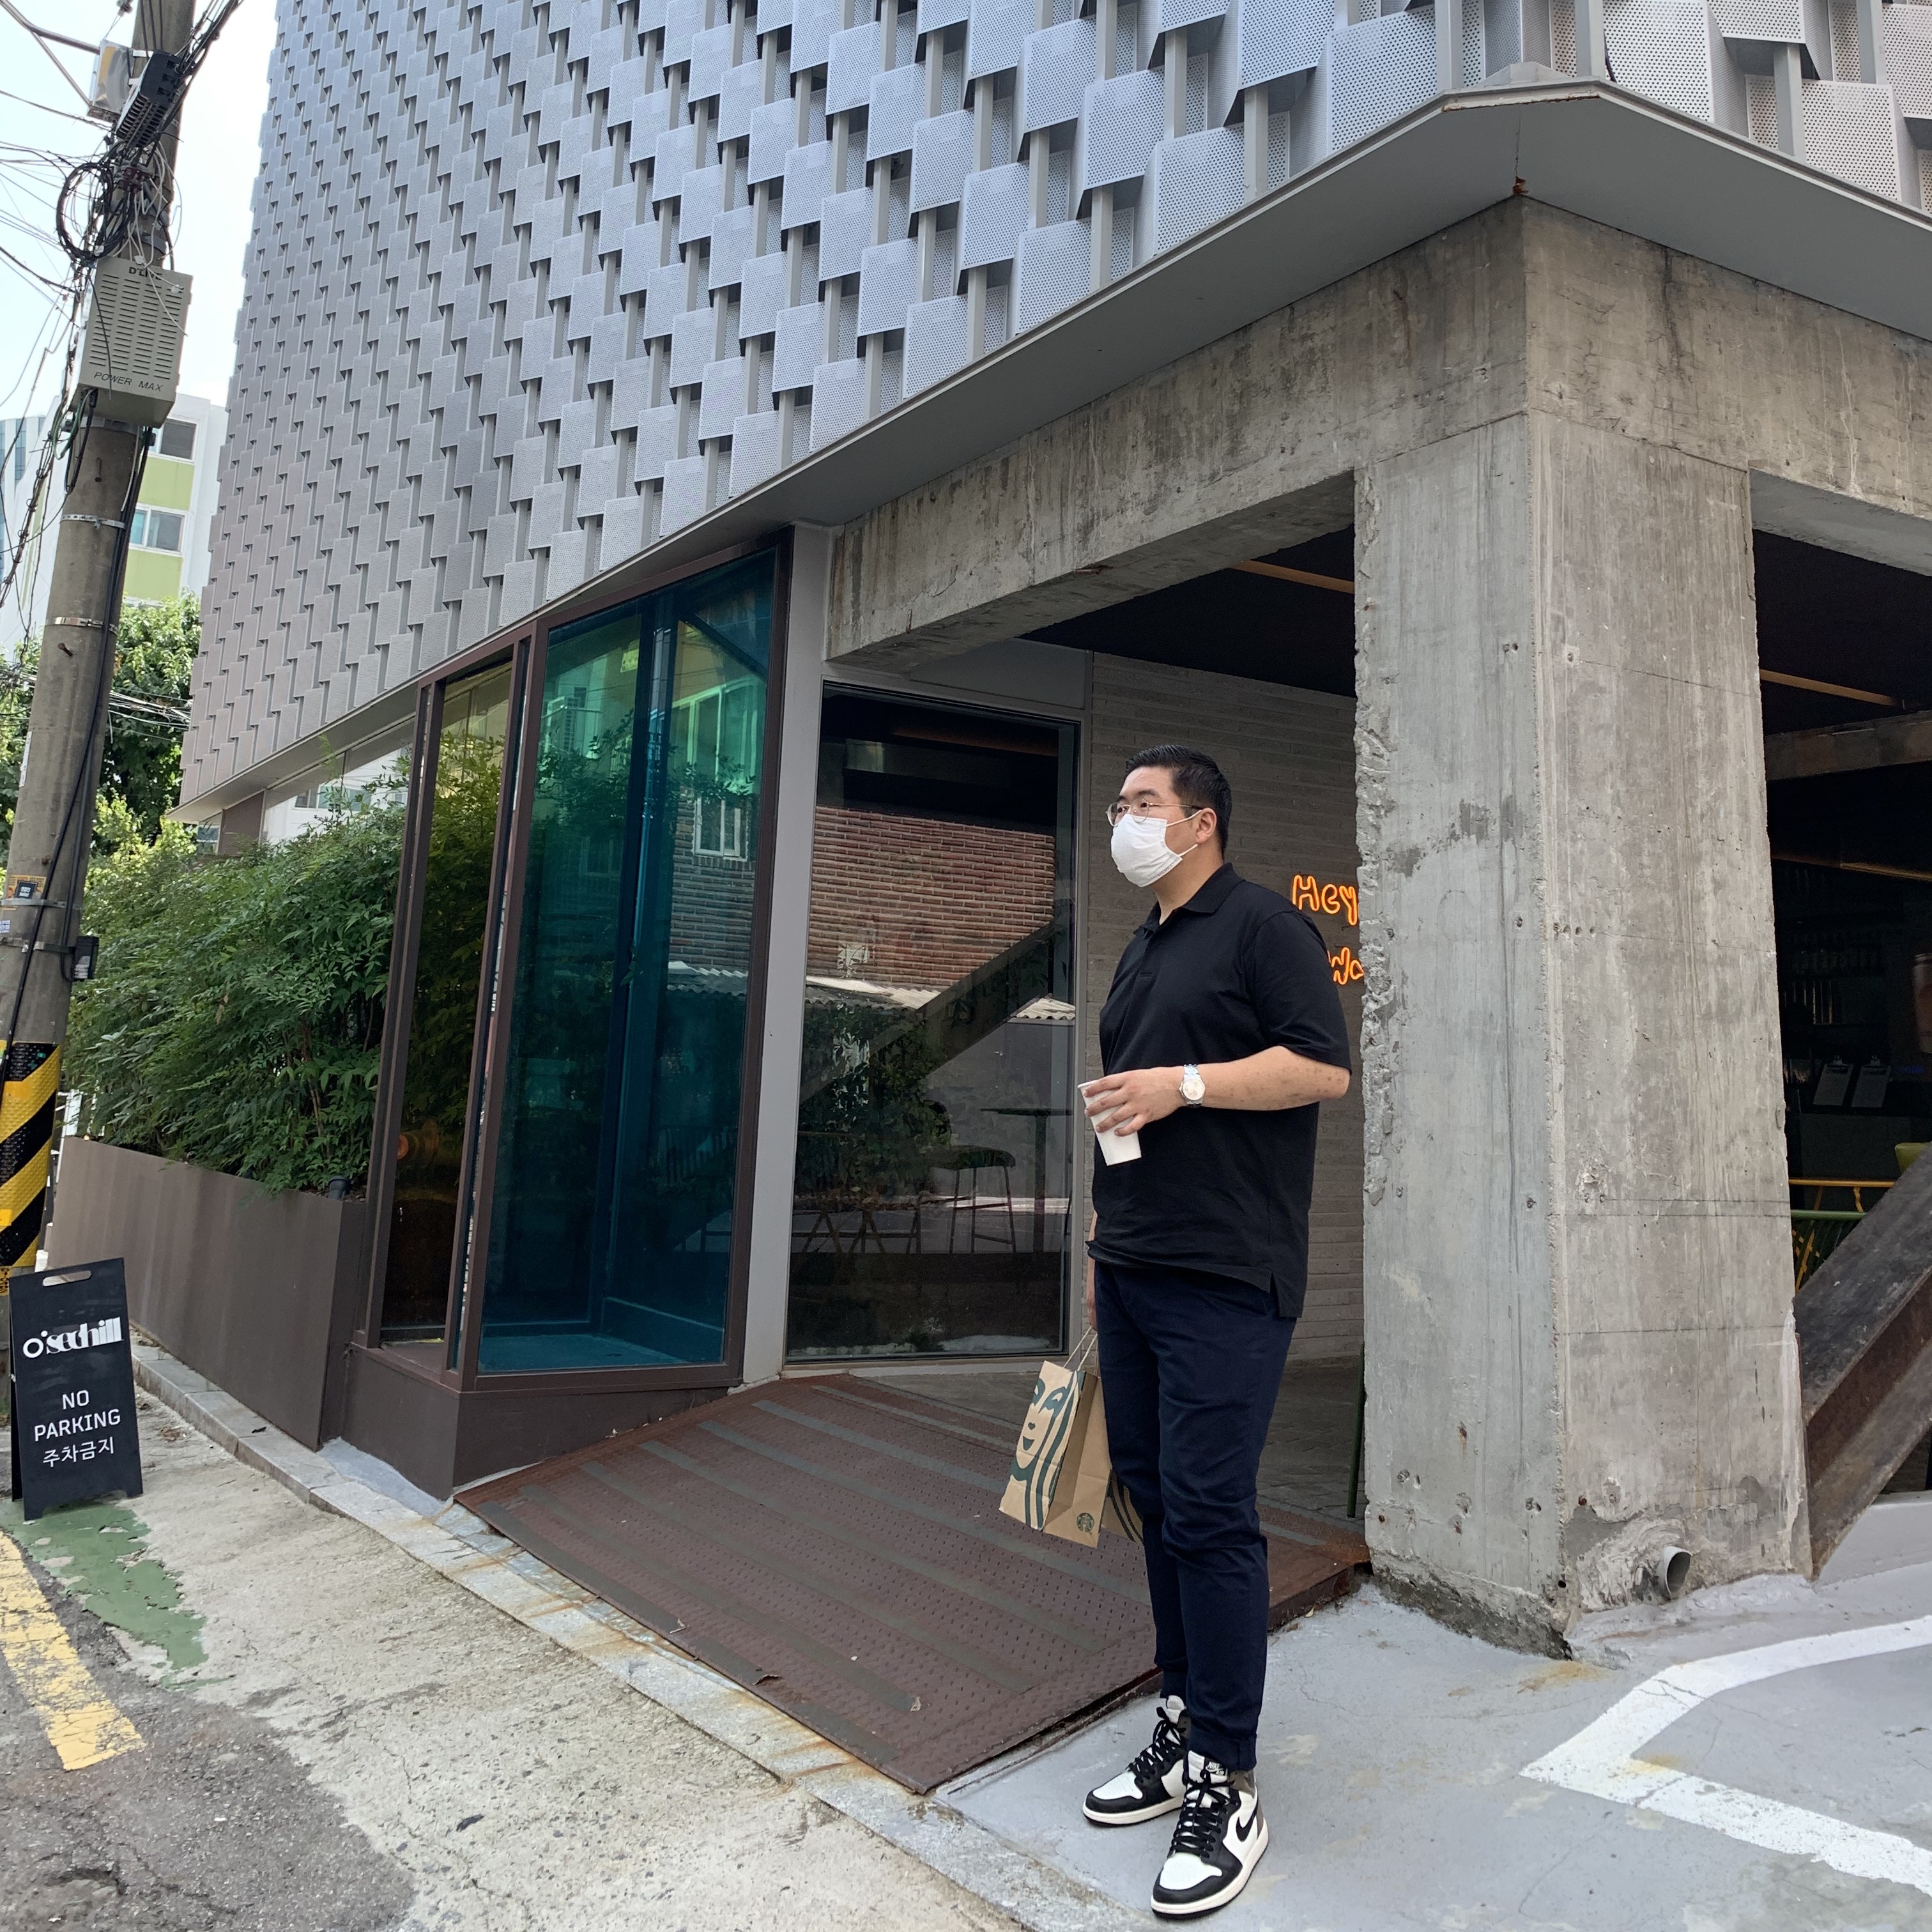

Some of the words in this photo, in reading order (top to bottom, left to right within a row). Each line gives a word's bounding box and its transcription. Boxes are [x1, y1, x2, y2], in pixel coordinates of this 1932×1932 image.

[93, 372, 132, 386] POWER
[138, 381, 164, 392] MAX
[1292, 875, 1358, 926] Hey
[62, 1390, 89, 1410] NO
[34, 1409, 121, 1442] PARKING
[43, 1436, 114, 1468] 주차금지
